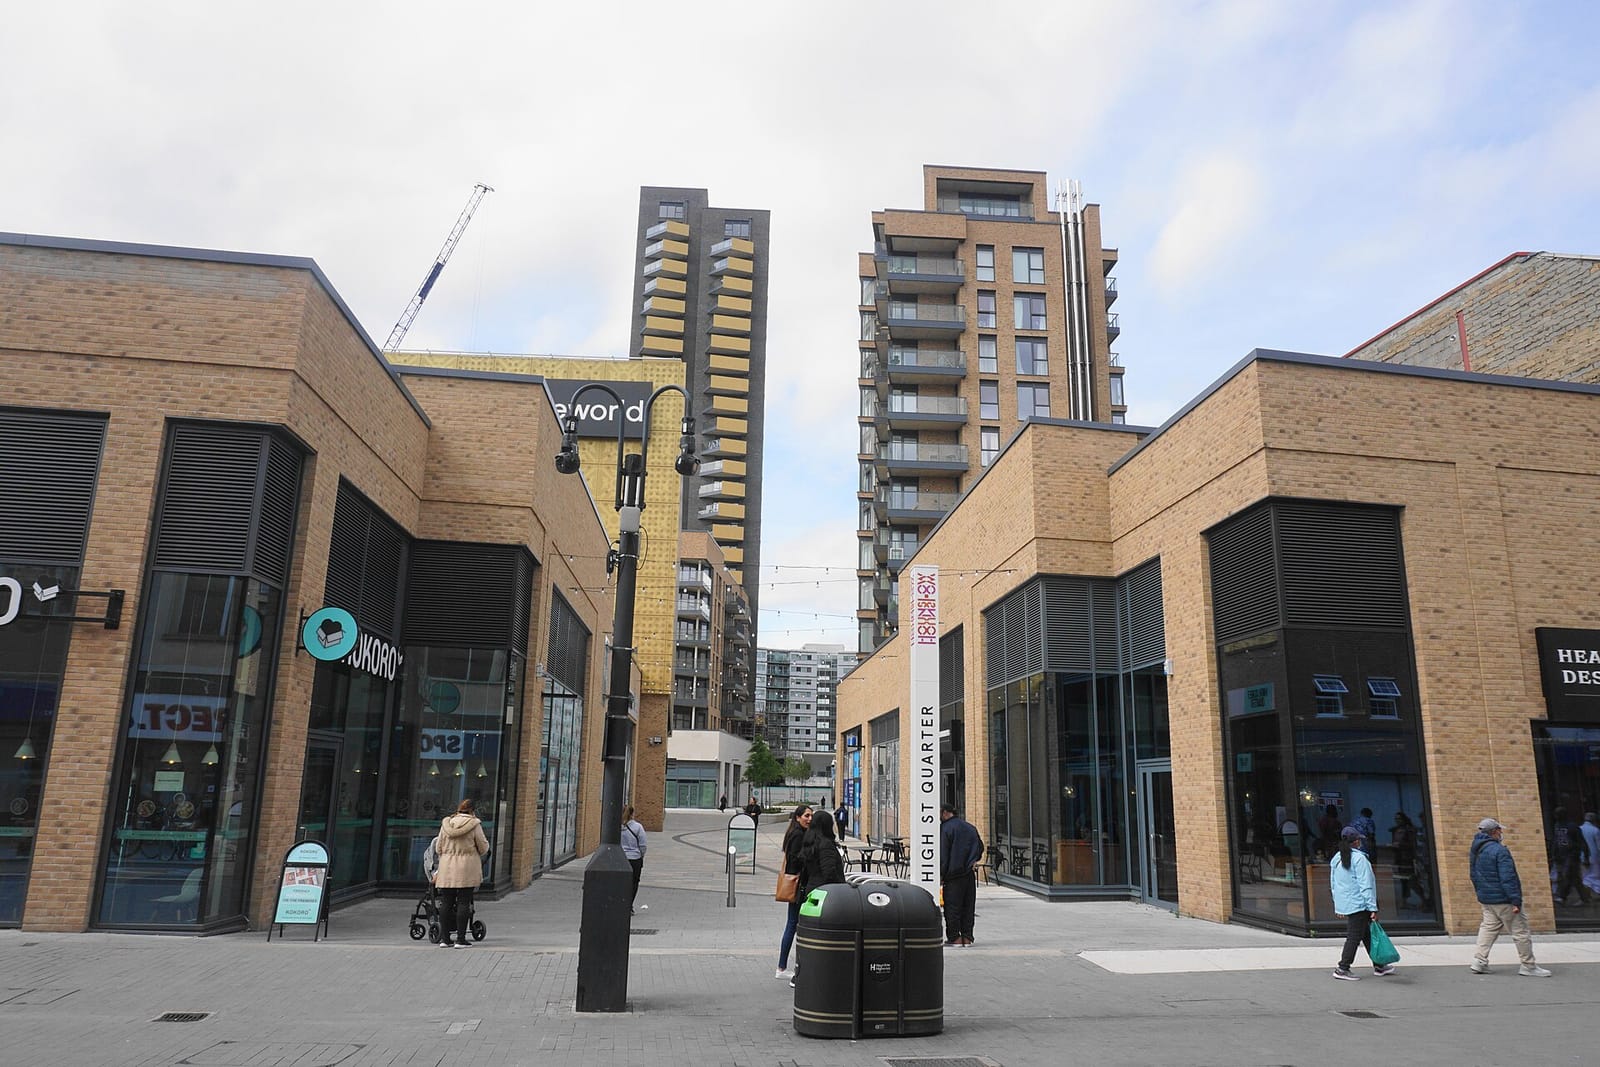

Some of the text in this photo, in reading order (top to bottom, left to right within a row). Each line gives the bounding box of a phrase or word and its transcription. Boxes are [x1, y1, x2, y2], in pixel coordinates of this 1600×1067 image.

[555, 399, 643, 422] eword
[341, 633, 397, 681] OKORO
[1557, 649, 1600, 664] HEA
[1562, 669, 1600, 685] DES
[921, 705, 934, 882] HIGH ST QUARTER
